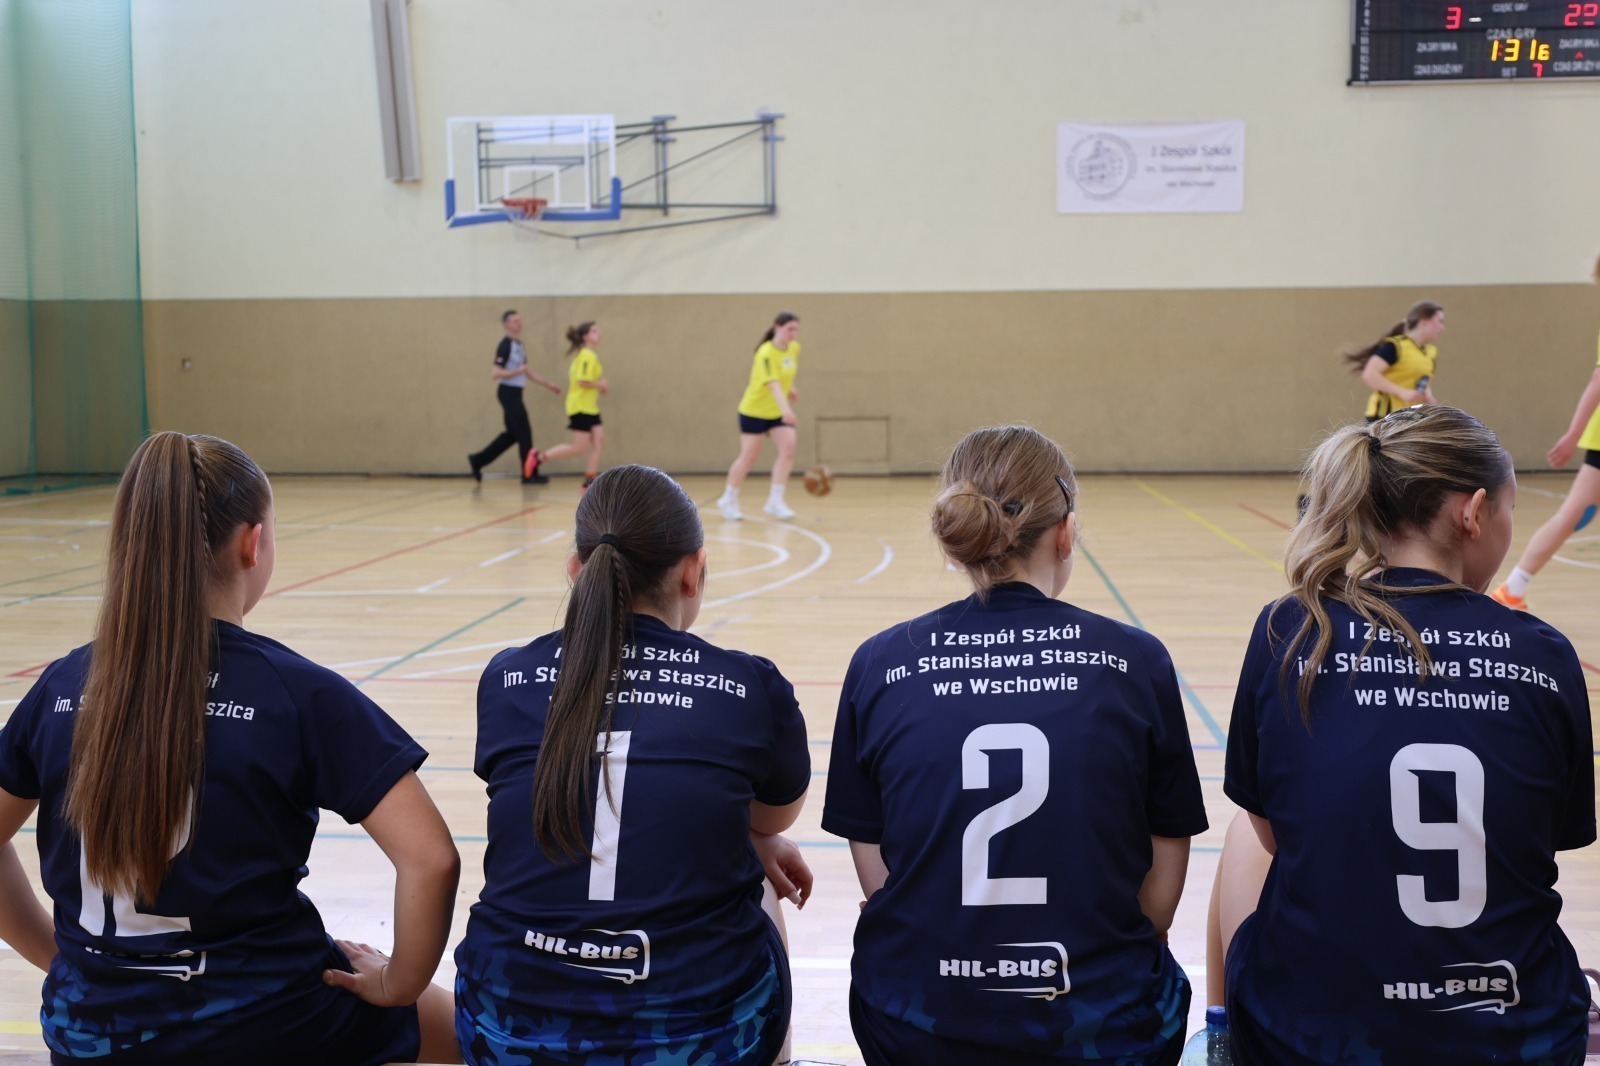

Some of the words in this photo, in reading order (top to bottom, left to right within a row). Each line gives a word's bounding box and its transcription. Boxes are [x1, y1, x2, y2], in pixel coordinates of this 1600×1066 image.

[1445, 6, 1462, 30] 3
[931, 632, 937, 646] I
[943, 629, 1016, 648] Zespół
[1022, 624, 1081, 642] Szkół
[1349, 621, 1355, 639] I
[1448, 630, 1511, 648] Szkół
[643, 646, 700, 664] Szkół
[885, 665, 912, 684] im.
[918, 652, 1034, 673] Stanisława
[1041, 649, 1128, 673] Staszica
[503, 669, 528, 688] im.
[658, 668, 747, 698] Staszica
[933, 681, 962, 696] we
[970, 673, 1078, 695] Wschowie
[1469, 657, 1559, 693] Staszica
[54, 696, 73, 712] im.
[205, 700, 255, 720] szica
[605, 688, 693, 709] schowie
[1354, 688, 1387, 705] we
[1393, 687, 1510, 711] Wschowie
[961, 722, 1050, 906] 2
[1389, 742, 1487, 929] 9
